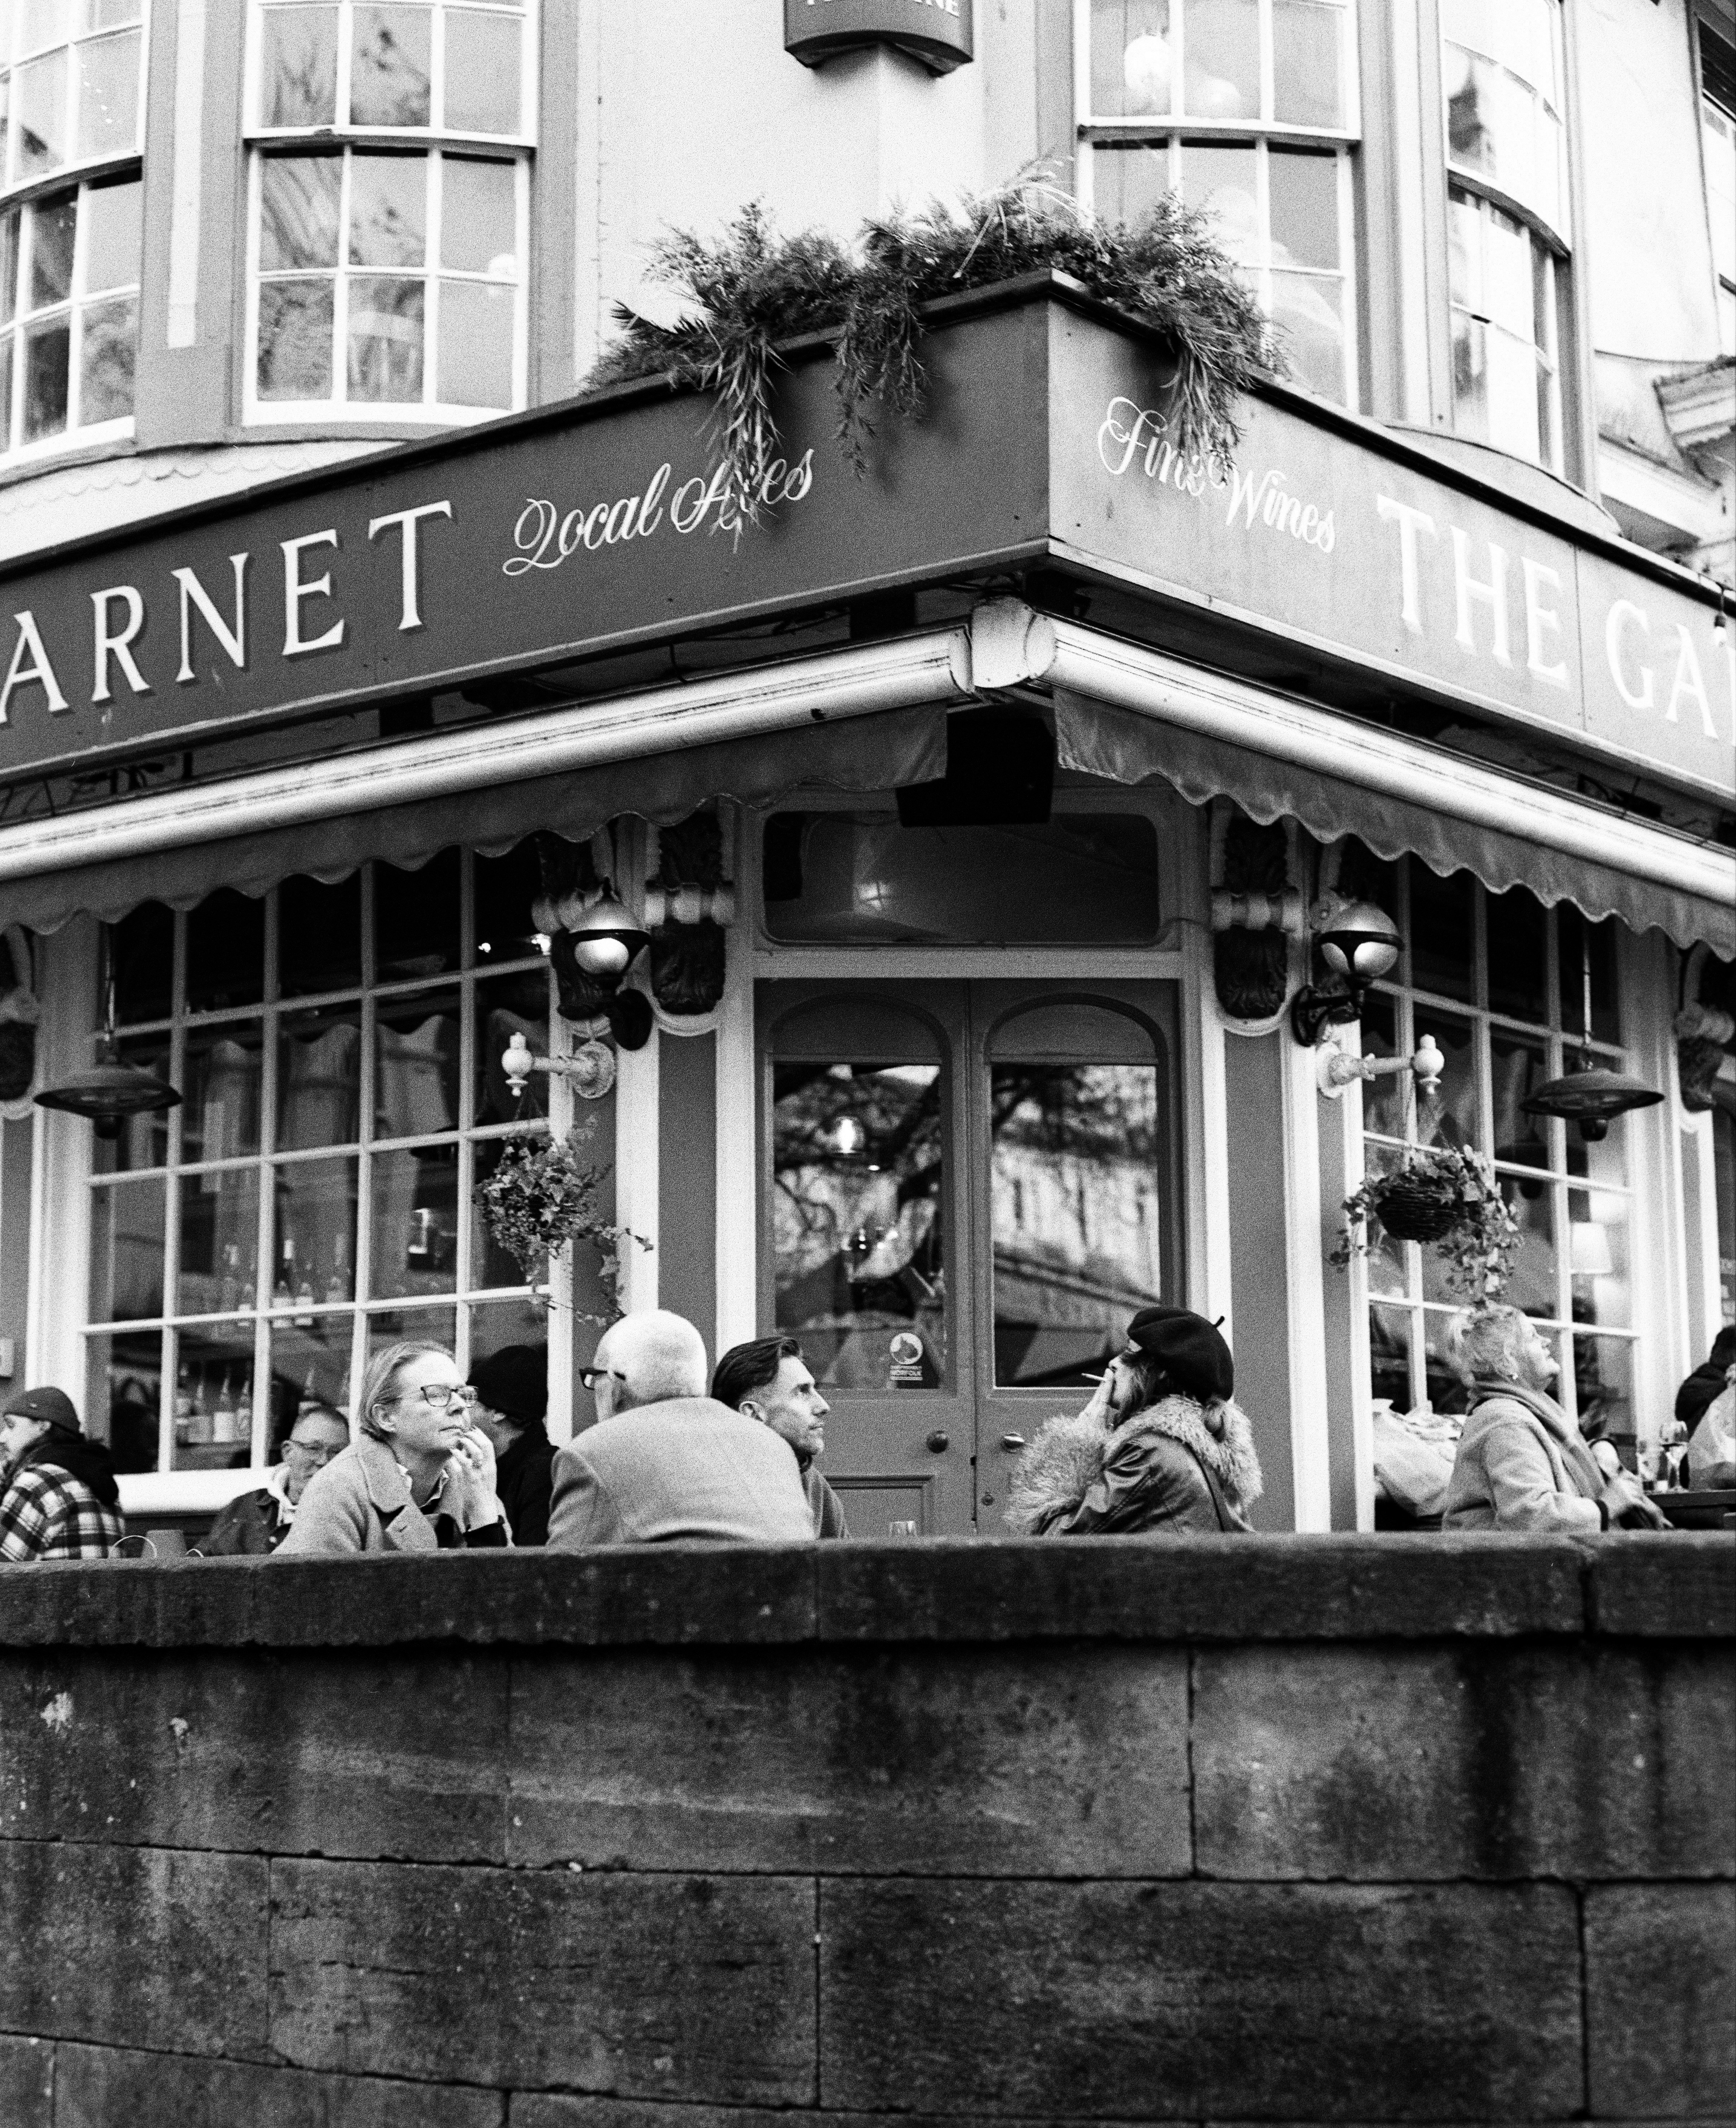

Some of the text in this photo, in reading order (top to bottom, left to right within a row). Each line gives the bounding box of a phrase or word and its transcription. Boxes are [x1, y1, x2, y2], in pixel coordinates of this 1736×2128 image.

[503, 463, 671, 576] Local
[1208, 452, 1335, 553] Wines
[1377, 493, 1736, 746] THE GA
